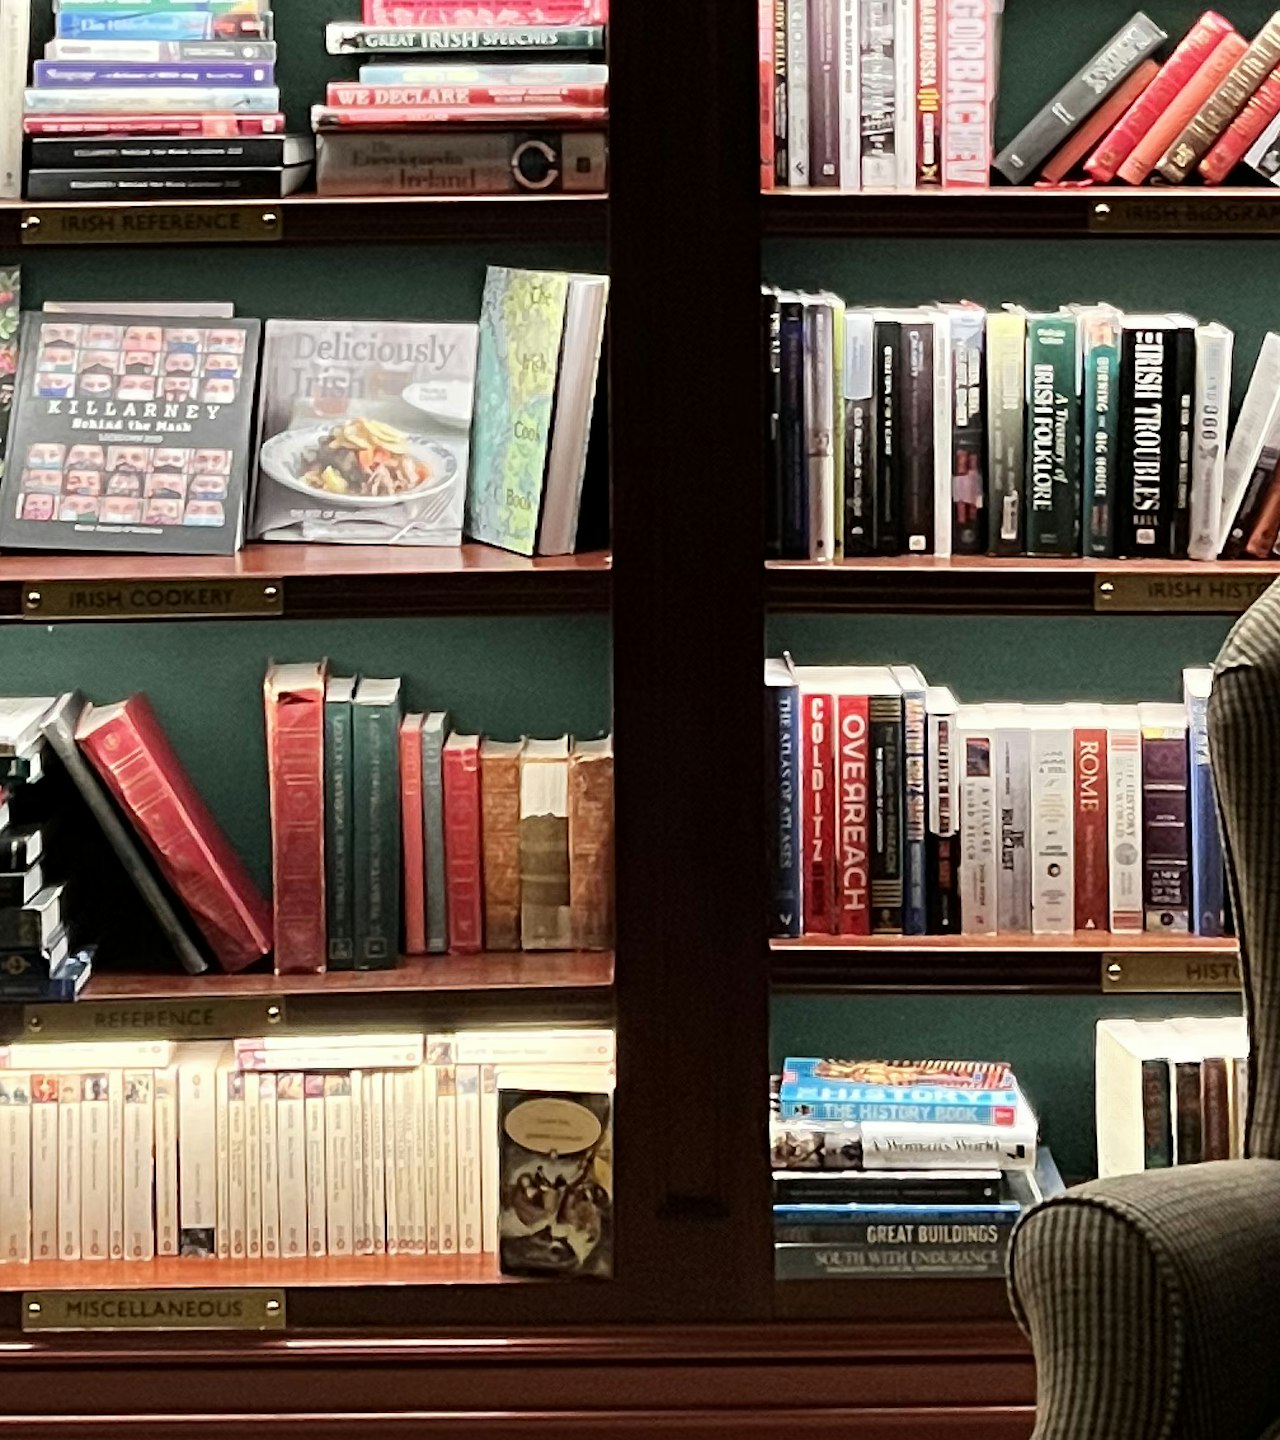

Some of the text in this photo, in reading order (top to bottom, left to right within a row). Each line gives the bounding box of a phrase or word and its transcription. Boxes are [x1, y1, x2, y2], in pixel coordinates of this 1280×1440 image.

[364, 30, 559, 49] GREAT IRISH SPEECHES
[336, 89, 369, 106] WE
[373, 88, 470, 106] DECLARE
[399, 167, 477, 189] Ireland
[60, 212, 241, 231] IRISH REFERENCE
[295, 331, 456, 367] Deliciously
[290, 367, 367, 400] Irish
[1095, 356, 1110, 412] BURNING
[1055, 392, 1068, 405] A
[48, 400, 220, 420] KILLARNEY
[71, 418, 123, 431] Behind
[127, 420, 152, 428] the
[513, 421, 541, 443] Cook
[1133, 344, 1164, 511] IRISH TROUBLES
[1032, 363, 1055, 511] IRISH FOLKLORE
[1094, 431, 1108, 453] BIG
[1094, 456, 1108, 497] HOUSE
[505, 489, 532, 509] Book
[72, 588, 235, 608] IRISH COOKERY
[1148, 581, 1201, 599] IRISH
[780, 696, 792, 869] THE ATLAS OF ATLASES
[811, 697, 824, 862] COLDITZ
[1079, 740, 1100, 813] ROME
[1125, 784, 1137, 838] HISTORY
[981, 800, 992, 854] VILLAGE
[966, 824, 976, 861] REICH
[1002, 808, 1014, 872] HOLOCAUST
[94, 1009, 214, 1028] REFERENCE
[823, 1104, 979, 1122] THE HISTORY BOOK
[954, 1138, 1003, 1153] World
[866, 1224, 999, 1244] GREAT BUILDINGS
[869, 1250, 910, 1266] WITH
[910, 1249, 1000, 1266] ENDURANCE
[66, 1298, 244, 1320] MISCELLANEOUS
